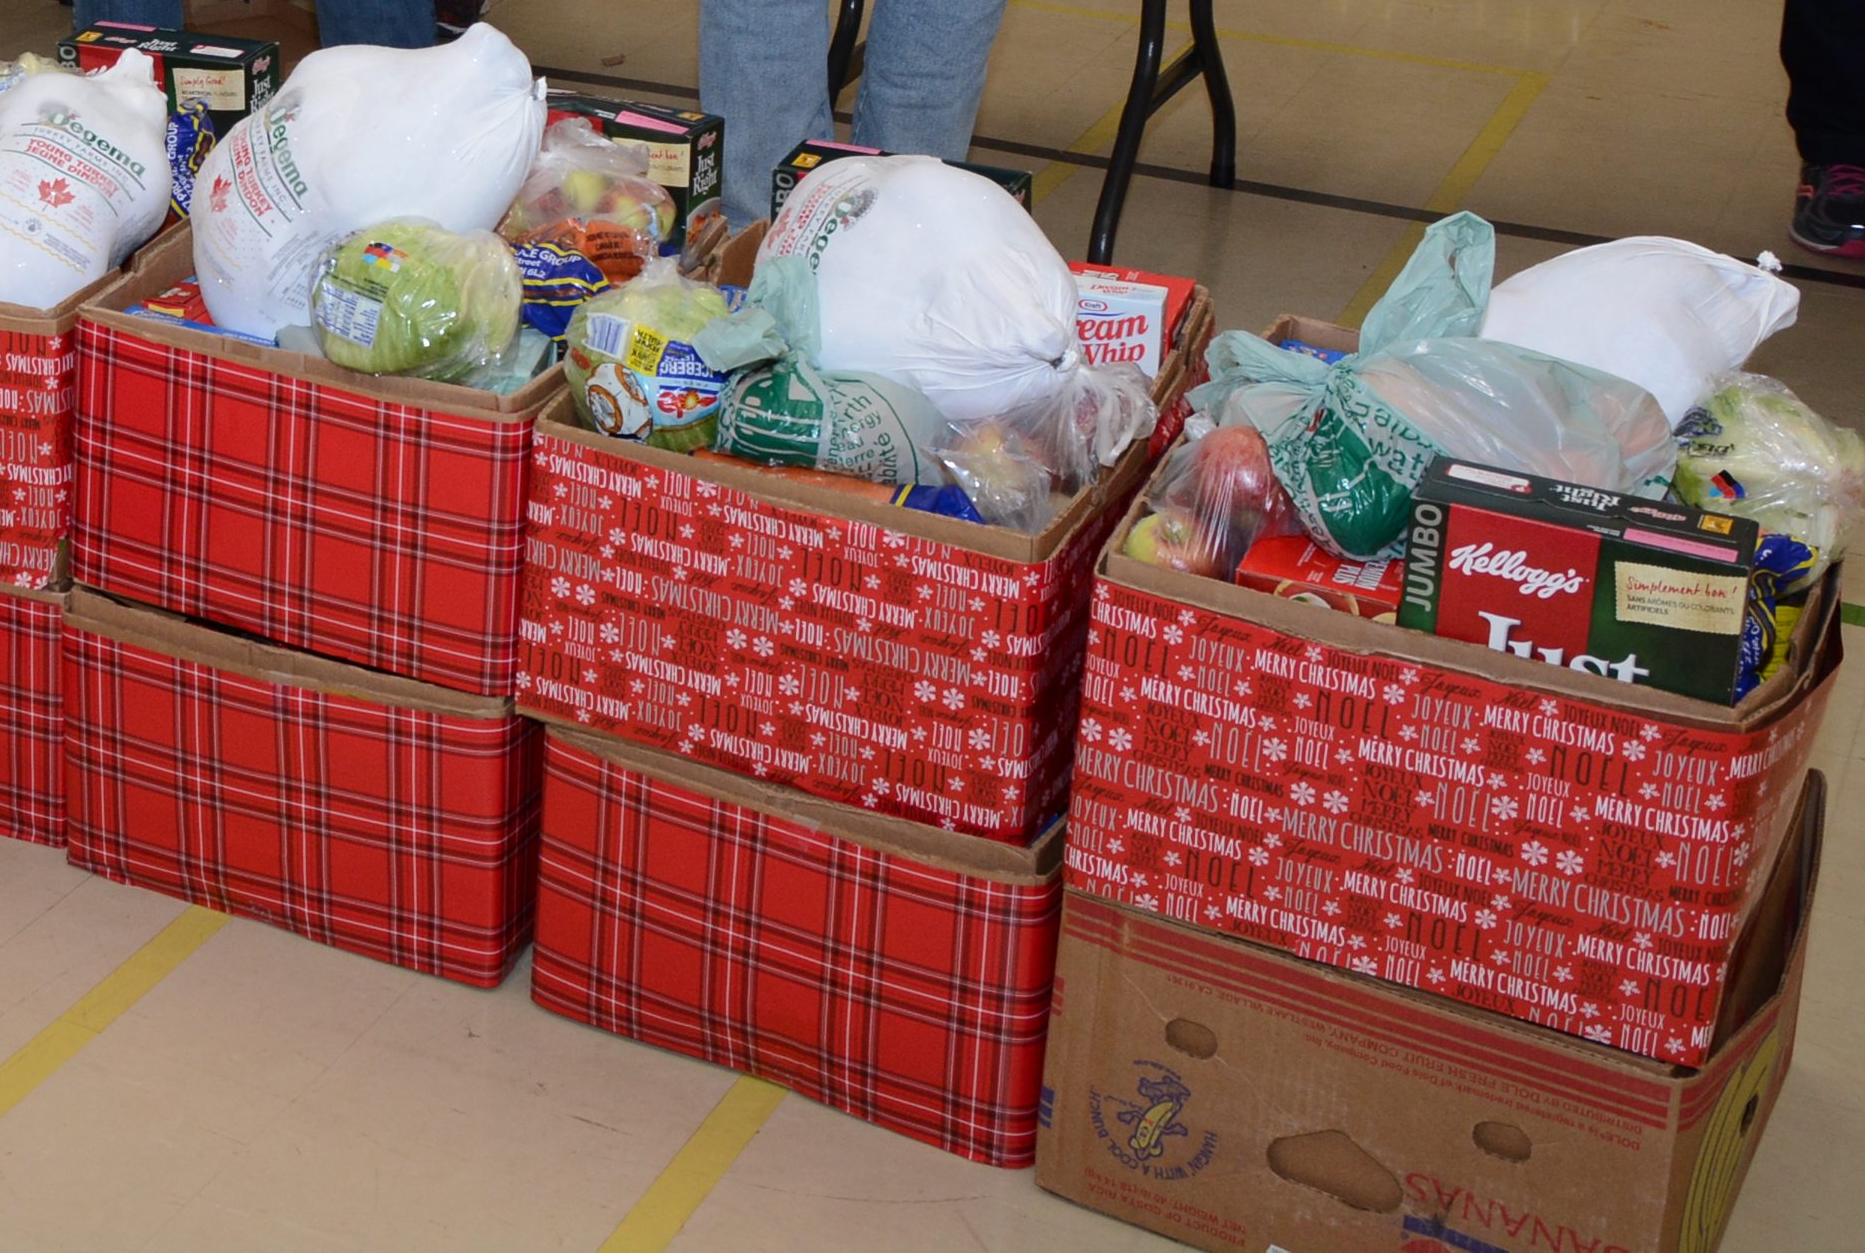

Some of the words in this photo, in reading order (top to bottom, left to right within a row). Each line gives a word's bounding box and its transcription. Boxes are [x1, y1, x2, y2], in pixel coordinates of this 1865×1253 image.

[167, 122, 179, 160] GROUP
[24, 145, 67, 170] JEUNE
[28, 137, 74, 165] YOUNG
[74, 158, 121, 195] TURKEY
[696, 153, 715, 174] Just
[247, 167, 274, 213] TURKEY
[692, 171, 718, 196] Right
[539, 249, 583, 266] GROUP
[658, 361, 714, 378] ICEBERG
[548, 452, 608, 488] CHRISTMAS
[610, 469, 642, 499] MERRY
[1554, 484, 1622, 507] Right
[1562, 493, 1608, 511] Just
[1406, 504, 1443, 612] JUMBO
[1449, 542, 1584, 599] Kellogg's
[651, 574, 732, 623] CHRISTMAS
[1626, 576, 1701, 597] Simplement
[1705, 585, 1729, 599] bon
[1627, 595, 1645, 604] SANS
[733, 602, 780, 636] MERRY
[1091, 598, 1157, 639] CHRISTMAS
[1627, 604, 1669, 616] ARTIFICIELS
[1188, 635, 1244, 674] JOYEUX
[1255, 649, 1295, 679] MERRY
[1298, 661, 1376, 700] CHRISTMAS
[1484, 704, 1531, 737] MERRY
[1532, 715, 1615, 757] CHRISTMAS
[1653, 750, 1716, 787] JOYEUX
[1124, 760, 1219, 814] CHRISTMAS
[1512, 867, 1571, 909] MERRY
[1573, 884, 1685, 939] CHRISTMAS
[1405, 1049, 1444, 1073] FRUIT
[1448, 1063, 1488, 1086] FRESH
[1500, 1078, 1540, 1102] DOLE
[1086, 1182, 1117, 1200] RICA
[1121, 1193, 1162, 1217] COSTA
[1185, 1217, 1246, 1247] PRODUCT
